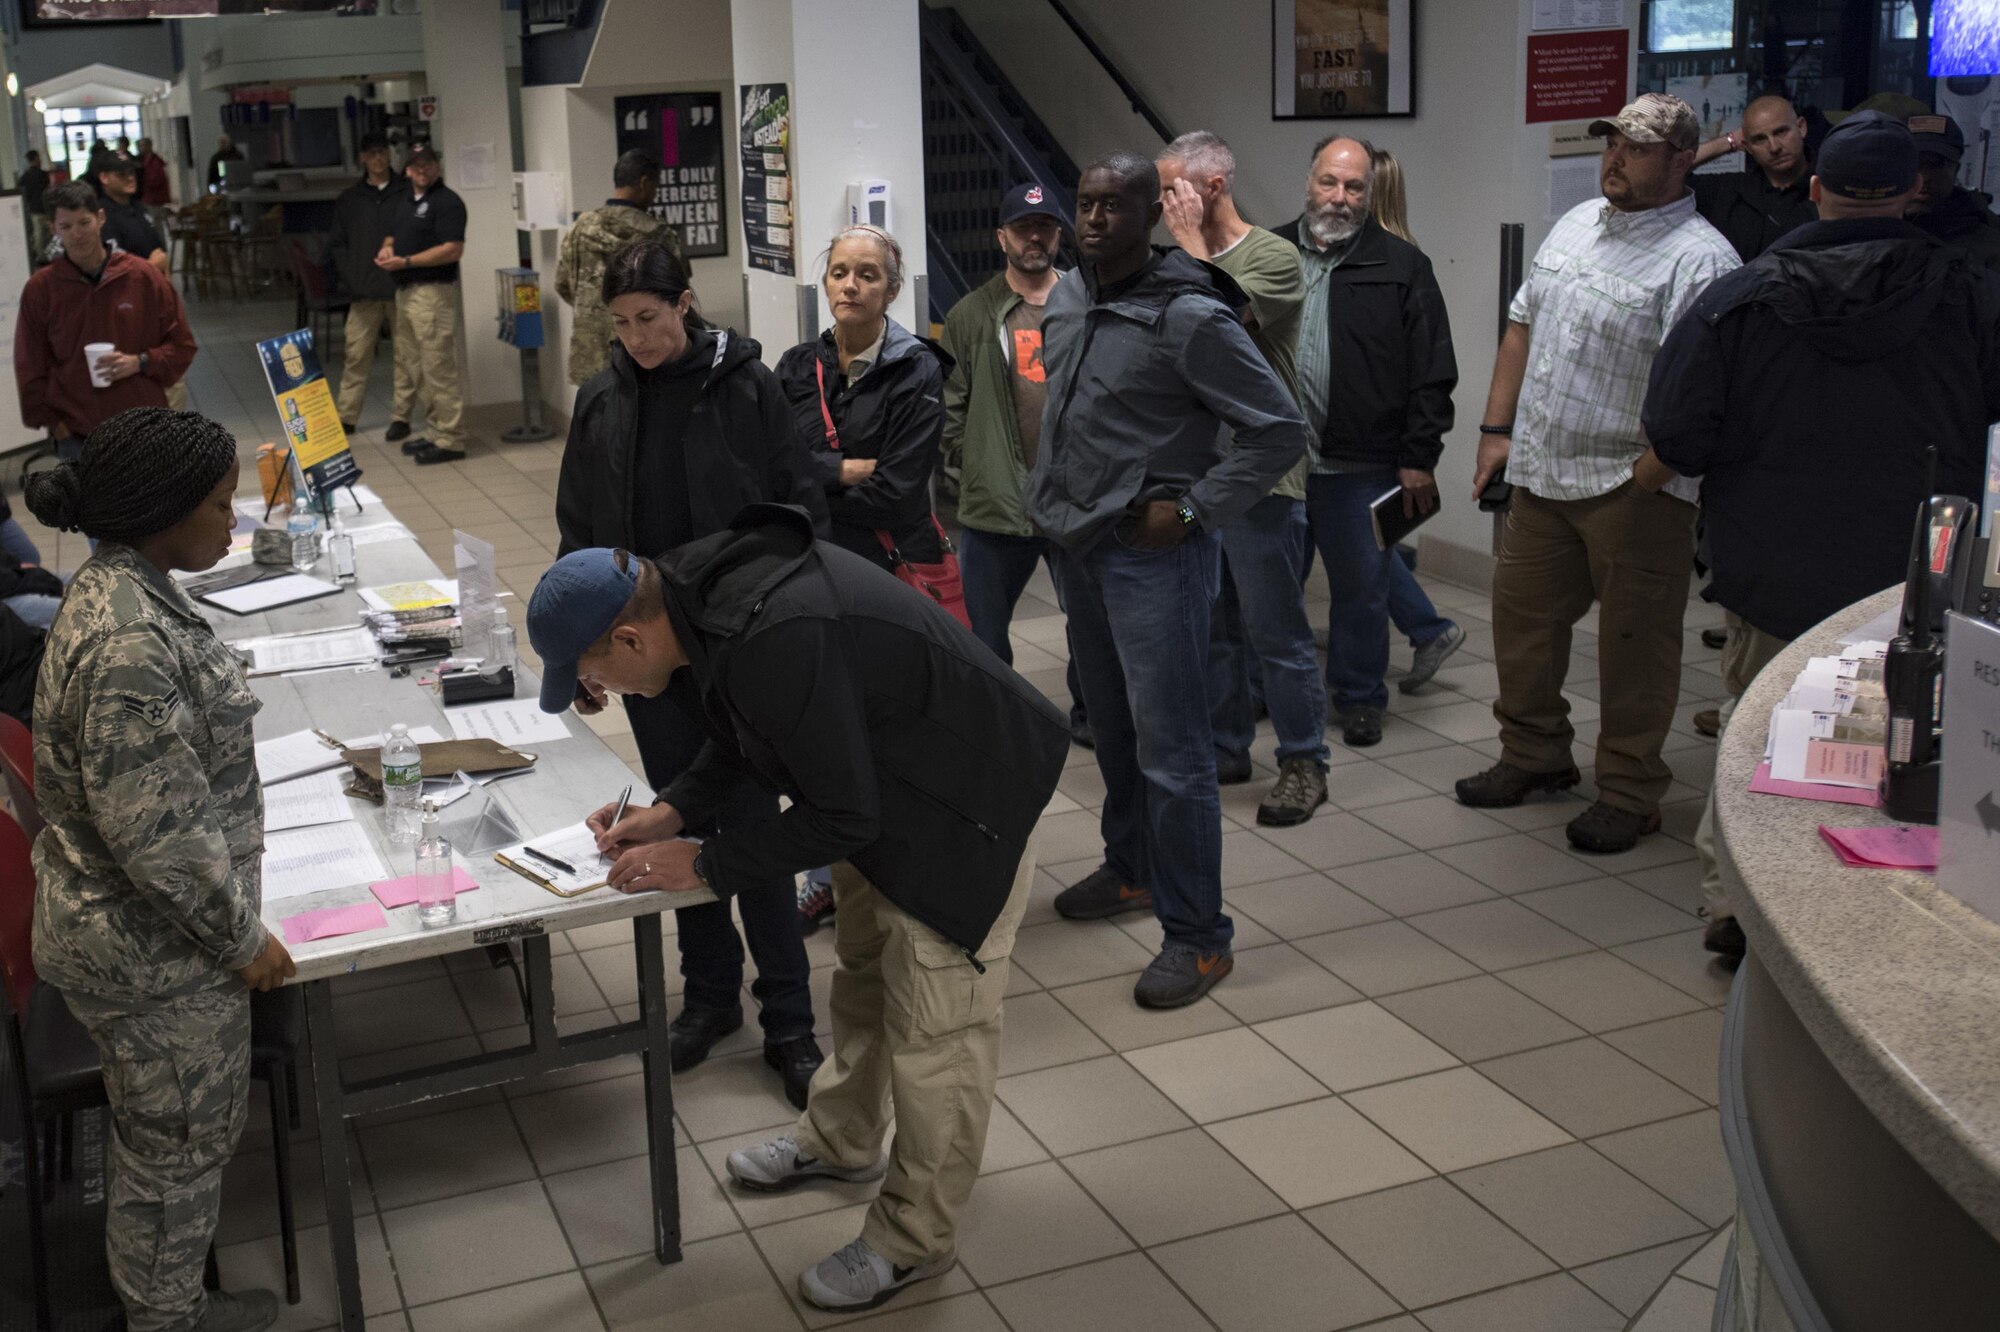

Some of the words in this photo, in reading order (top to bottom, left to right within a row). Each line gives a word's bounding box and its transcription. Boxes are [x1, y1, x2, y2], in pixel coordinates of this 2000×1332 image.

[1314, 48, 1355, 69] FAST
[659, 168, 676, 185] HE
[679, 166, 716, 184] ONLY
[653, 184, 718, 203] FERENCE
[646, 202, 718, 225] TWEEN
[686, 224, 719, 246] FAT
[83, 1144, 103, 1169] AIR
[83, 1173, 104, 1205] U.S.
